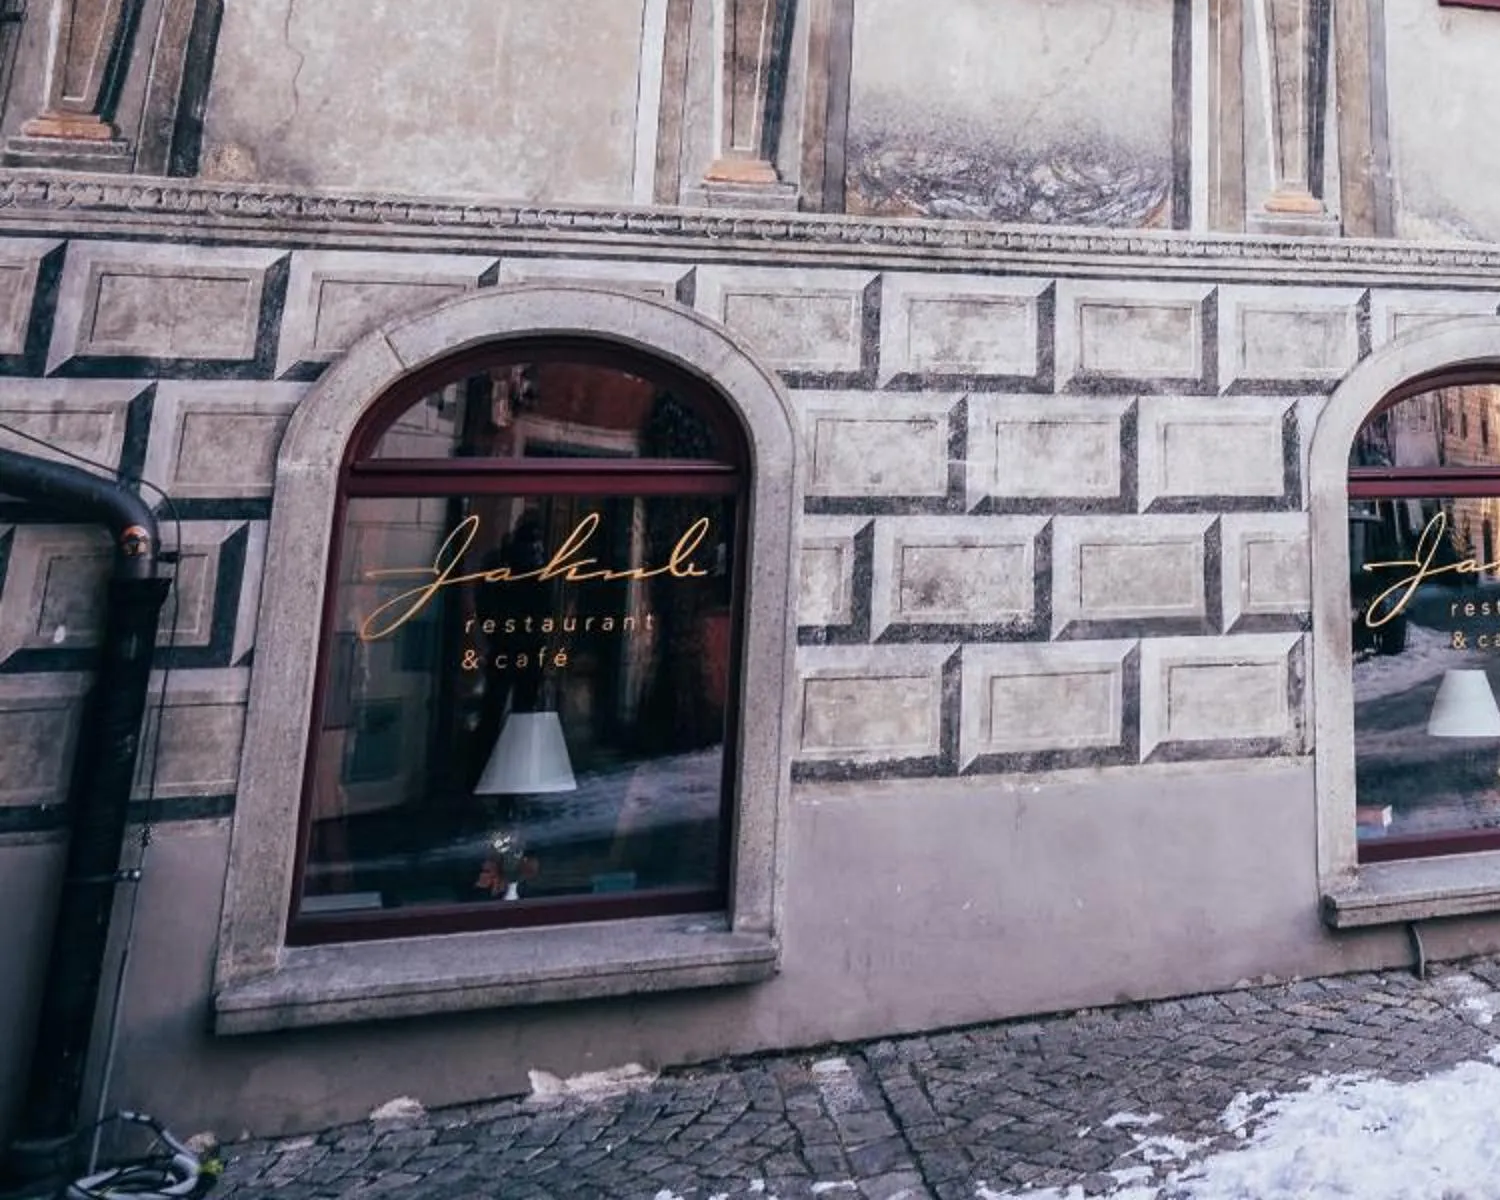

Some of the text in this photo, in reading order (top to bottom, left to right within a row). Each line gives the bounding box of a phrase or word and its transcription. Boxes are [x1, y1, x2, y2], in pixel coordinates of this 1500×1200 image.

[464, 613, 654, 634] restaurant
[1453, 632, 1468, 649] &
[461, 647, 569, 670] & café
